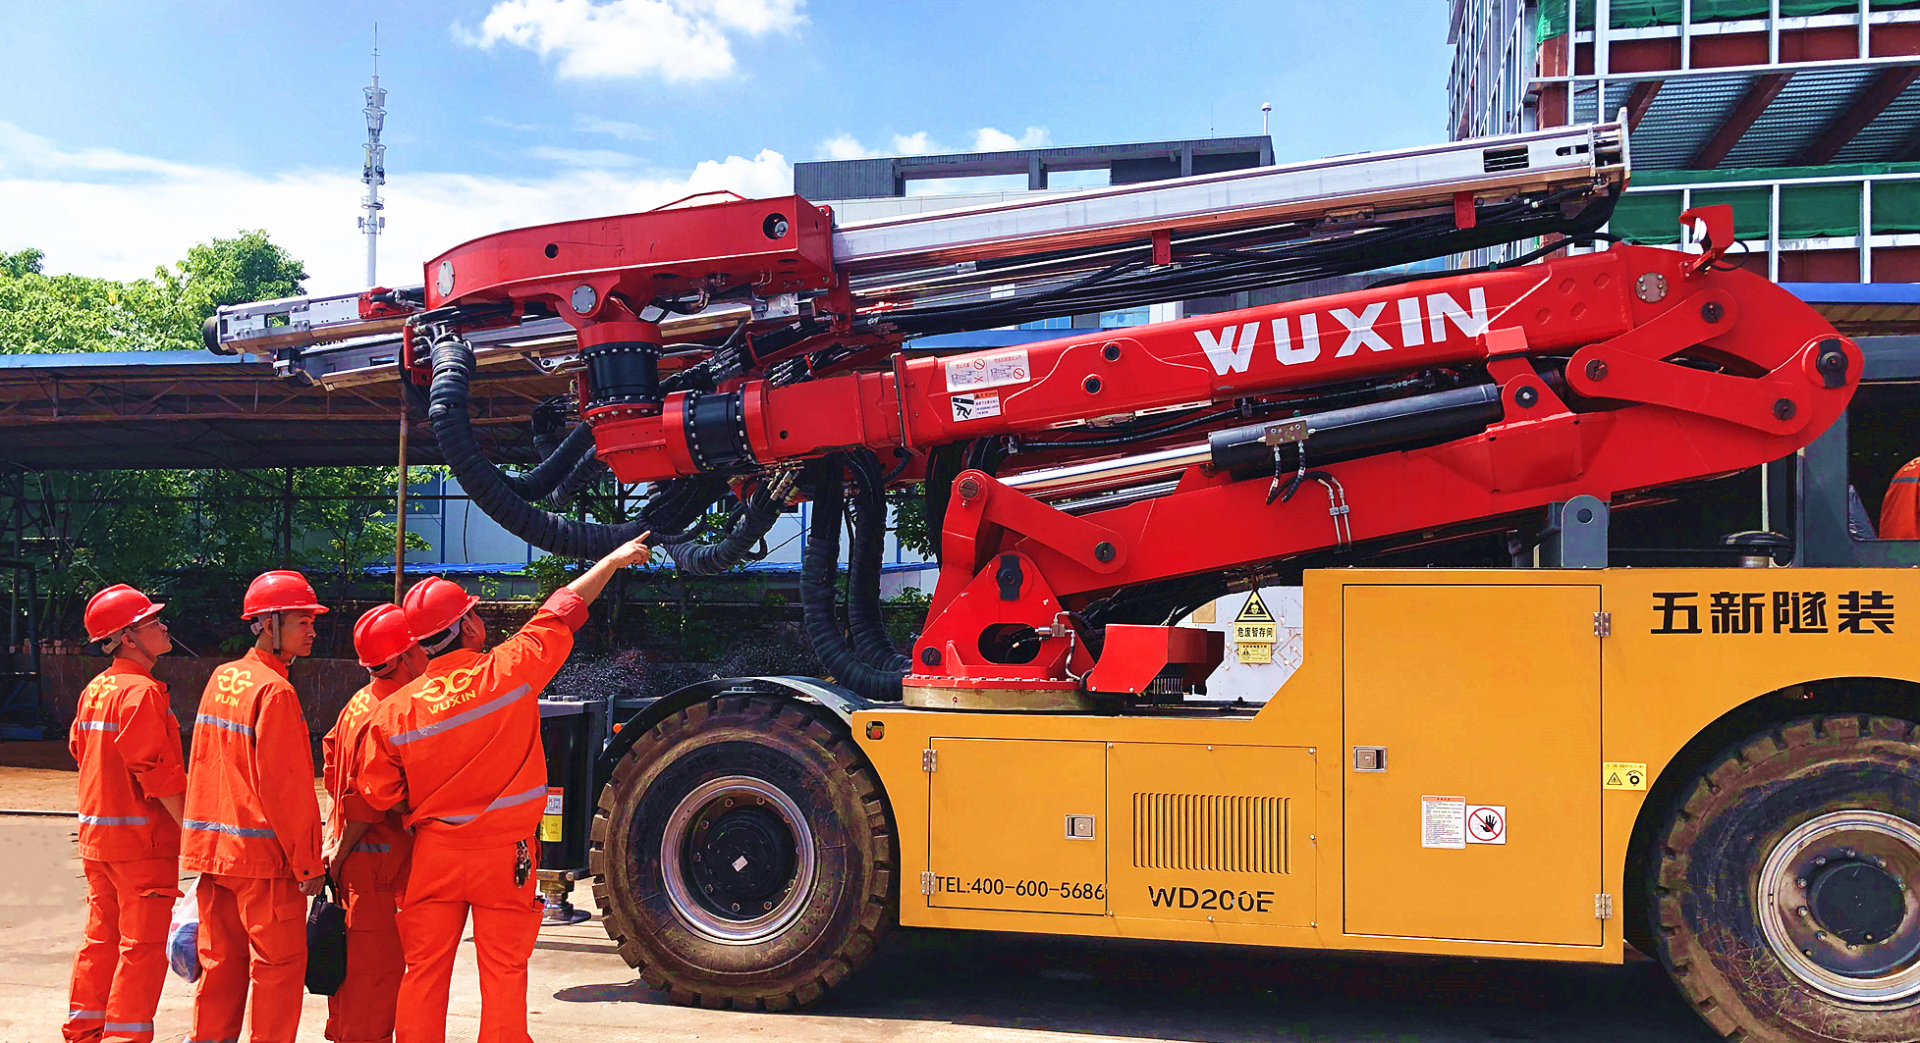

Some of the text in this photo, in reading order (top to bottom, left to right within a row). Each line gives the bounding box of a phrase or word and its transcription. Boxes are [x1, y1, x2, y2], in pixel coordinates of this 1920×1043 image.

[1194, 287, 1488, 376] WUXIN
[1651, 590, 1895, 635] 五新隧装
[427, 690, 476, 714] WUXIN
[1147, 885, 1275, 913] WD200E
